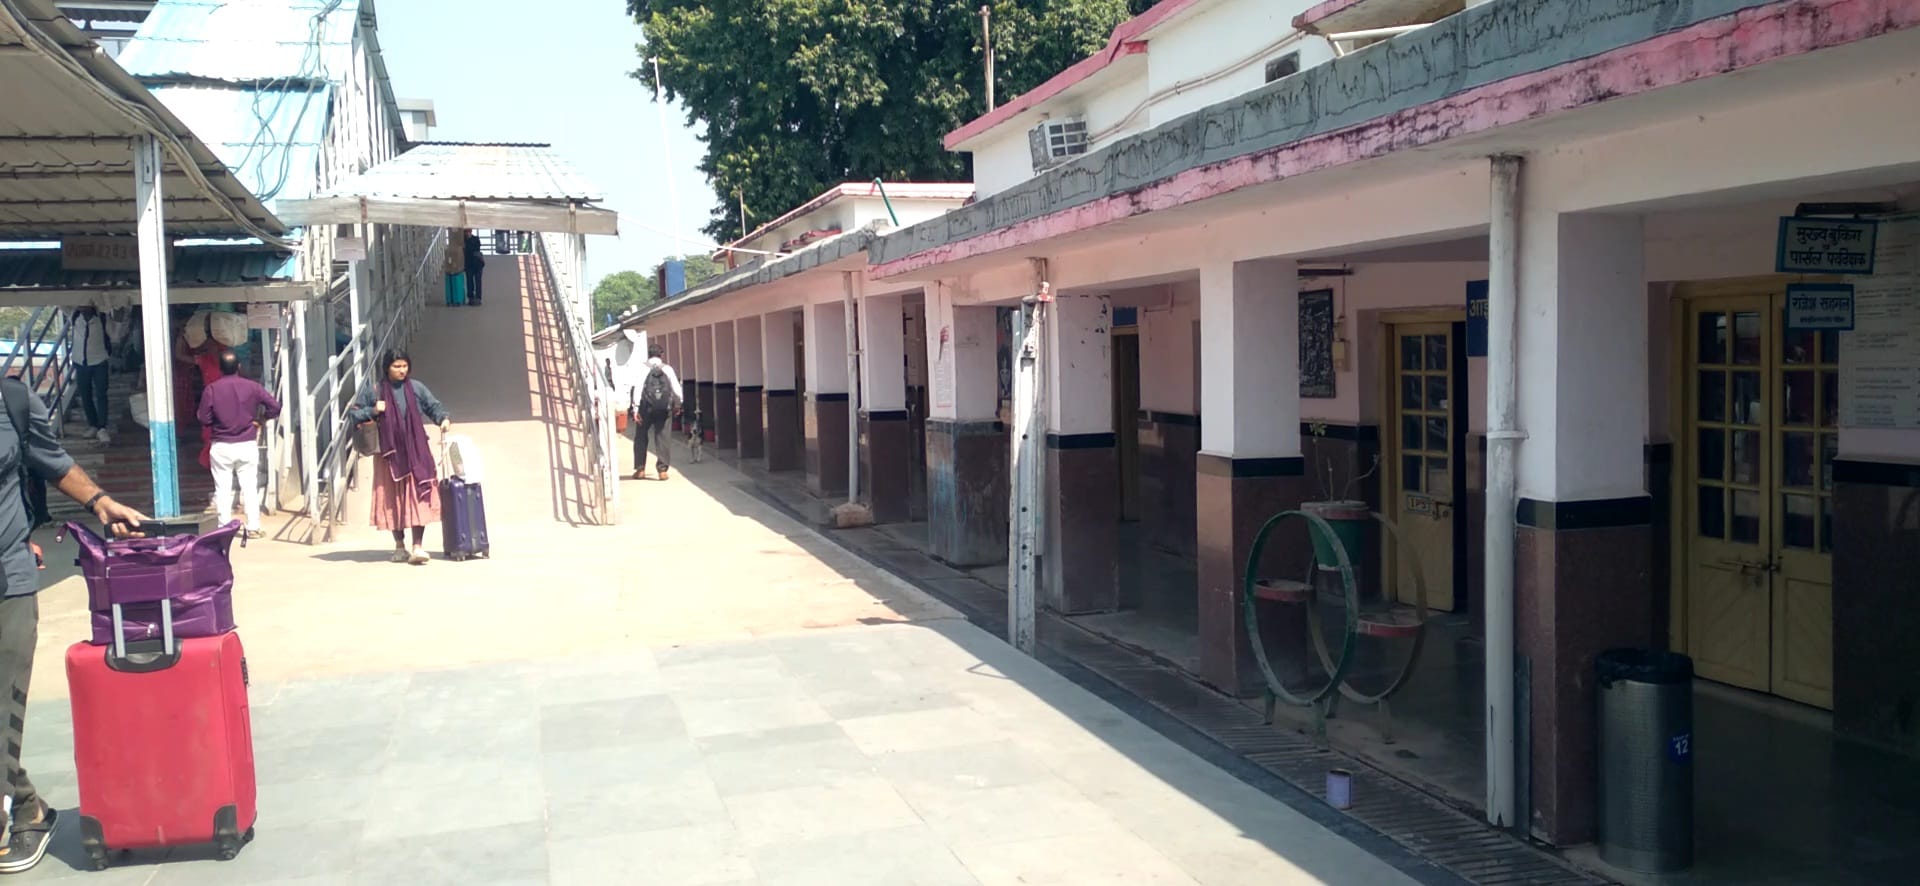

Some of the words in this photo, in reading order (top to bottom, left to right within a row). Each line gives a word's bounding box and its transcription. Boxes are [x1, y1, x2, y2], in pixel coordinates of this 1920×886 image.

[1796, 226, 1827, 244] मुख्य
[1829, 224, 1863, 245] बुकिंग
[1790, 246, 1823, 265] पार्सल
[1675, 739, 1688, 755] 12
